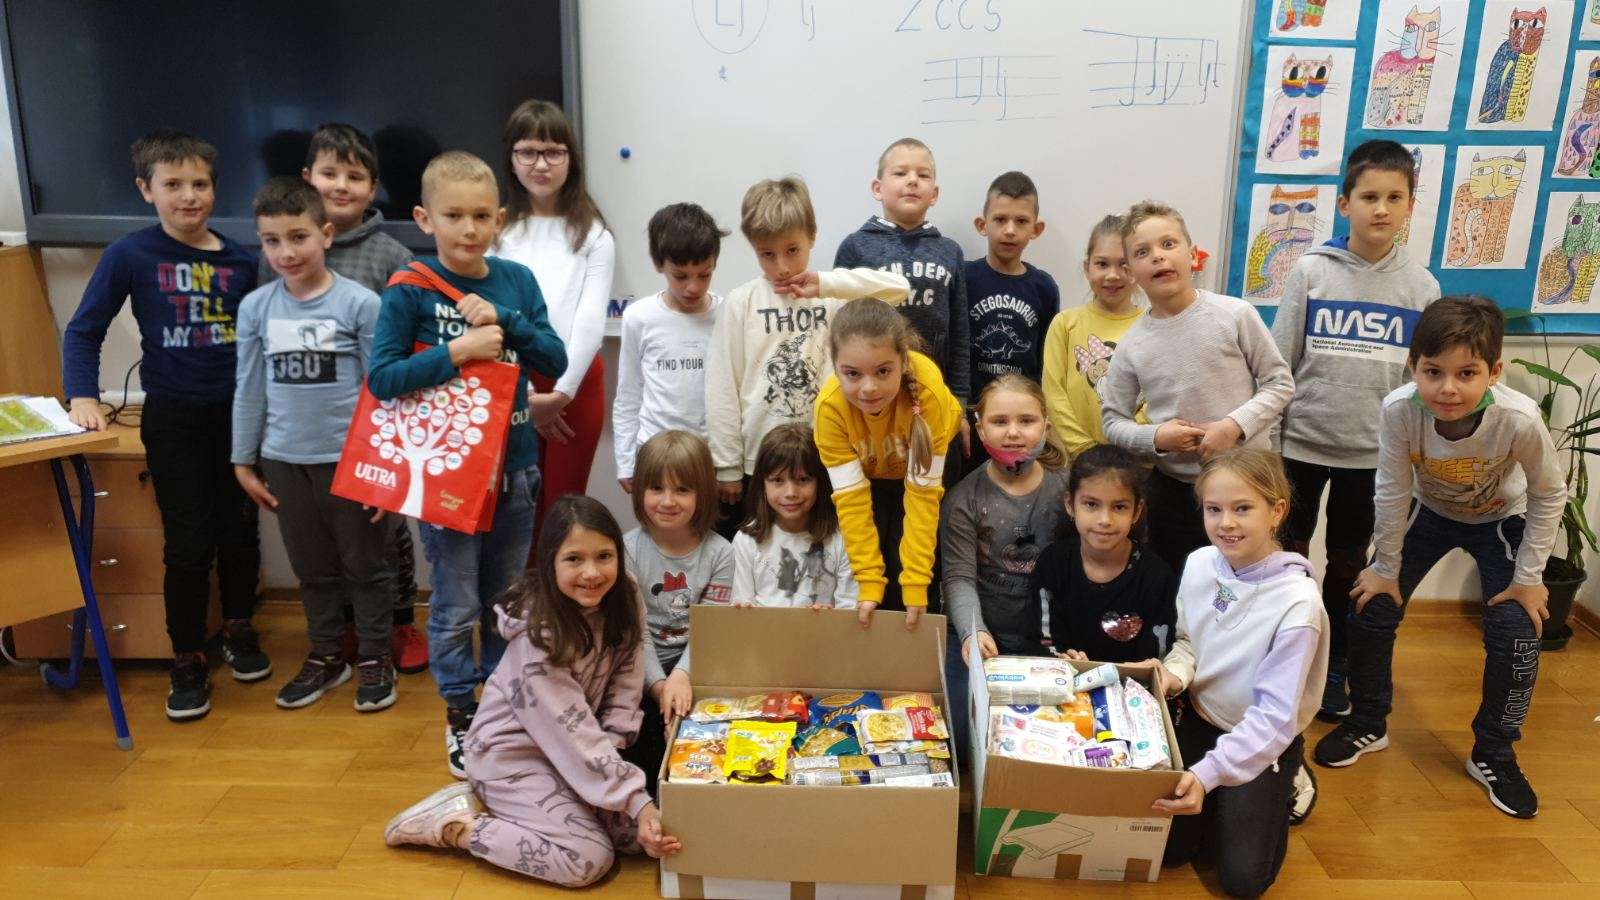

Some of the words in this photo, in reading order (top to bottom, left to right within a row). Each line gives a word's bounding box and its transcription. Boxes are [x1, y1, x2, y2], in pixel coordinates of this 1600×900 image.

[168, 295, 232, 324] TELL
[757, 302, 828, 334] THOR
[969, 294, 1039, 328] STEGOSAURUS
[1314, 307, 1403, 343] NASA
[162, 326, 191, 348] MY
[656, 359, 677, 371] FIND
[679, 358, 704, 370] YOUR
[354, 462, 397, 488] ULTRA
[1512, 638, 1538, 681] EPIC
[1500, 687, 1533, 727] RUN
